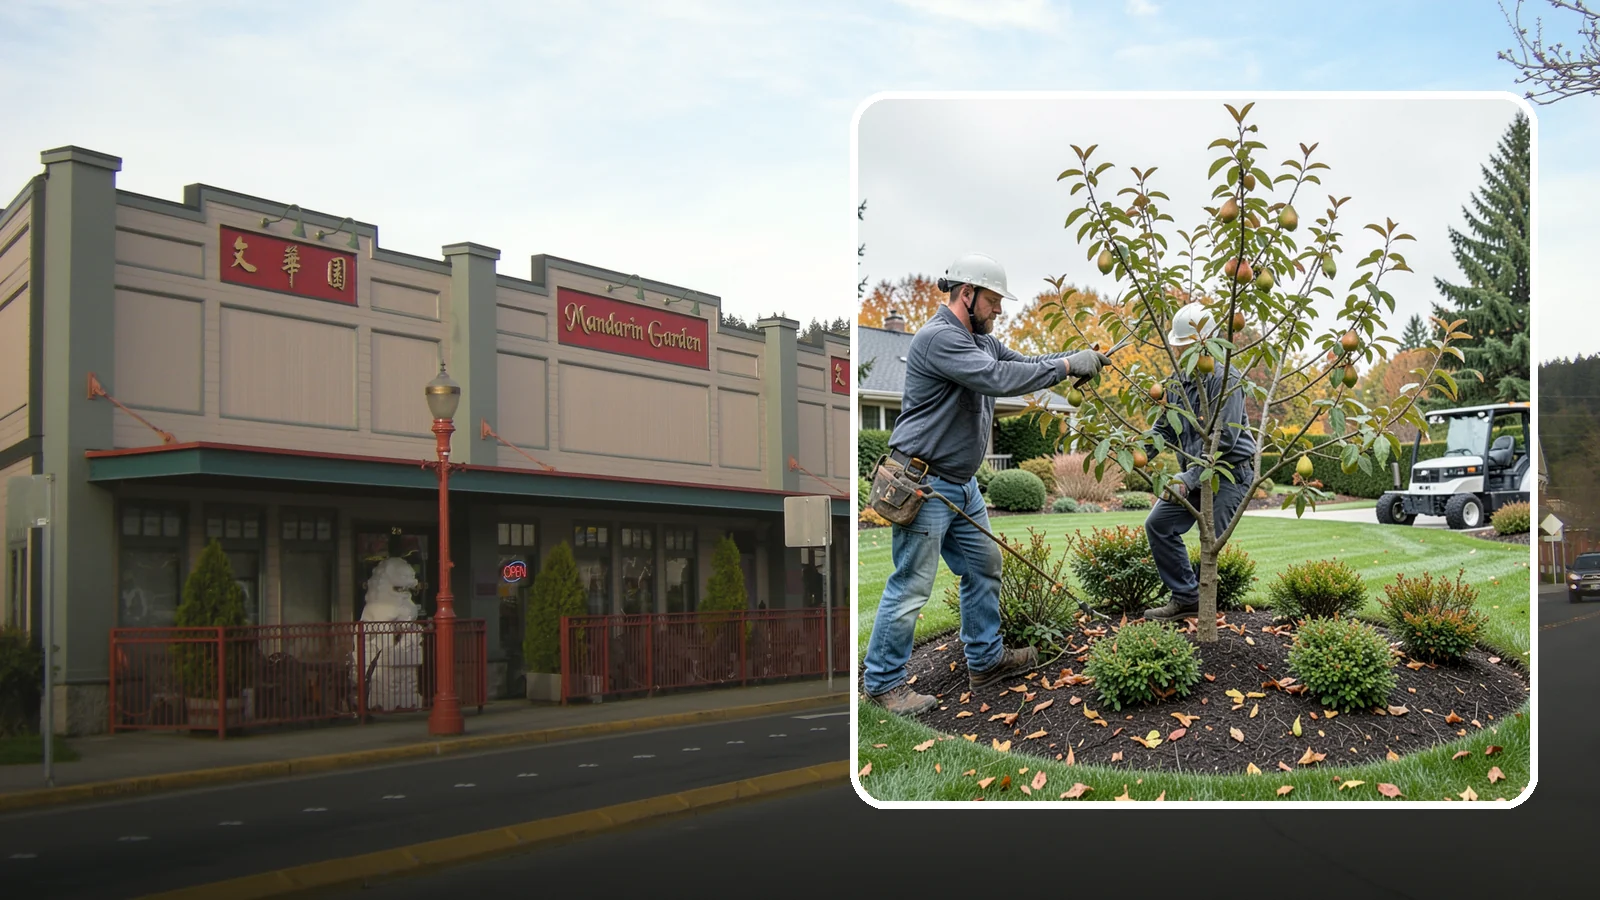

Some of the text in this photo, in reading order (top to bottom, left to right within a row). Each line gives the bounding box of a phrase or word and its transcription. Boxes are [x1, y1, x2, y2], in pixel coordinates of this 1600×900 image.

[231, 236, 346, 291] 文華園
[564, 302, 701, 352] Mandarin Garden
[503, 565, 527, 578] OPEN
